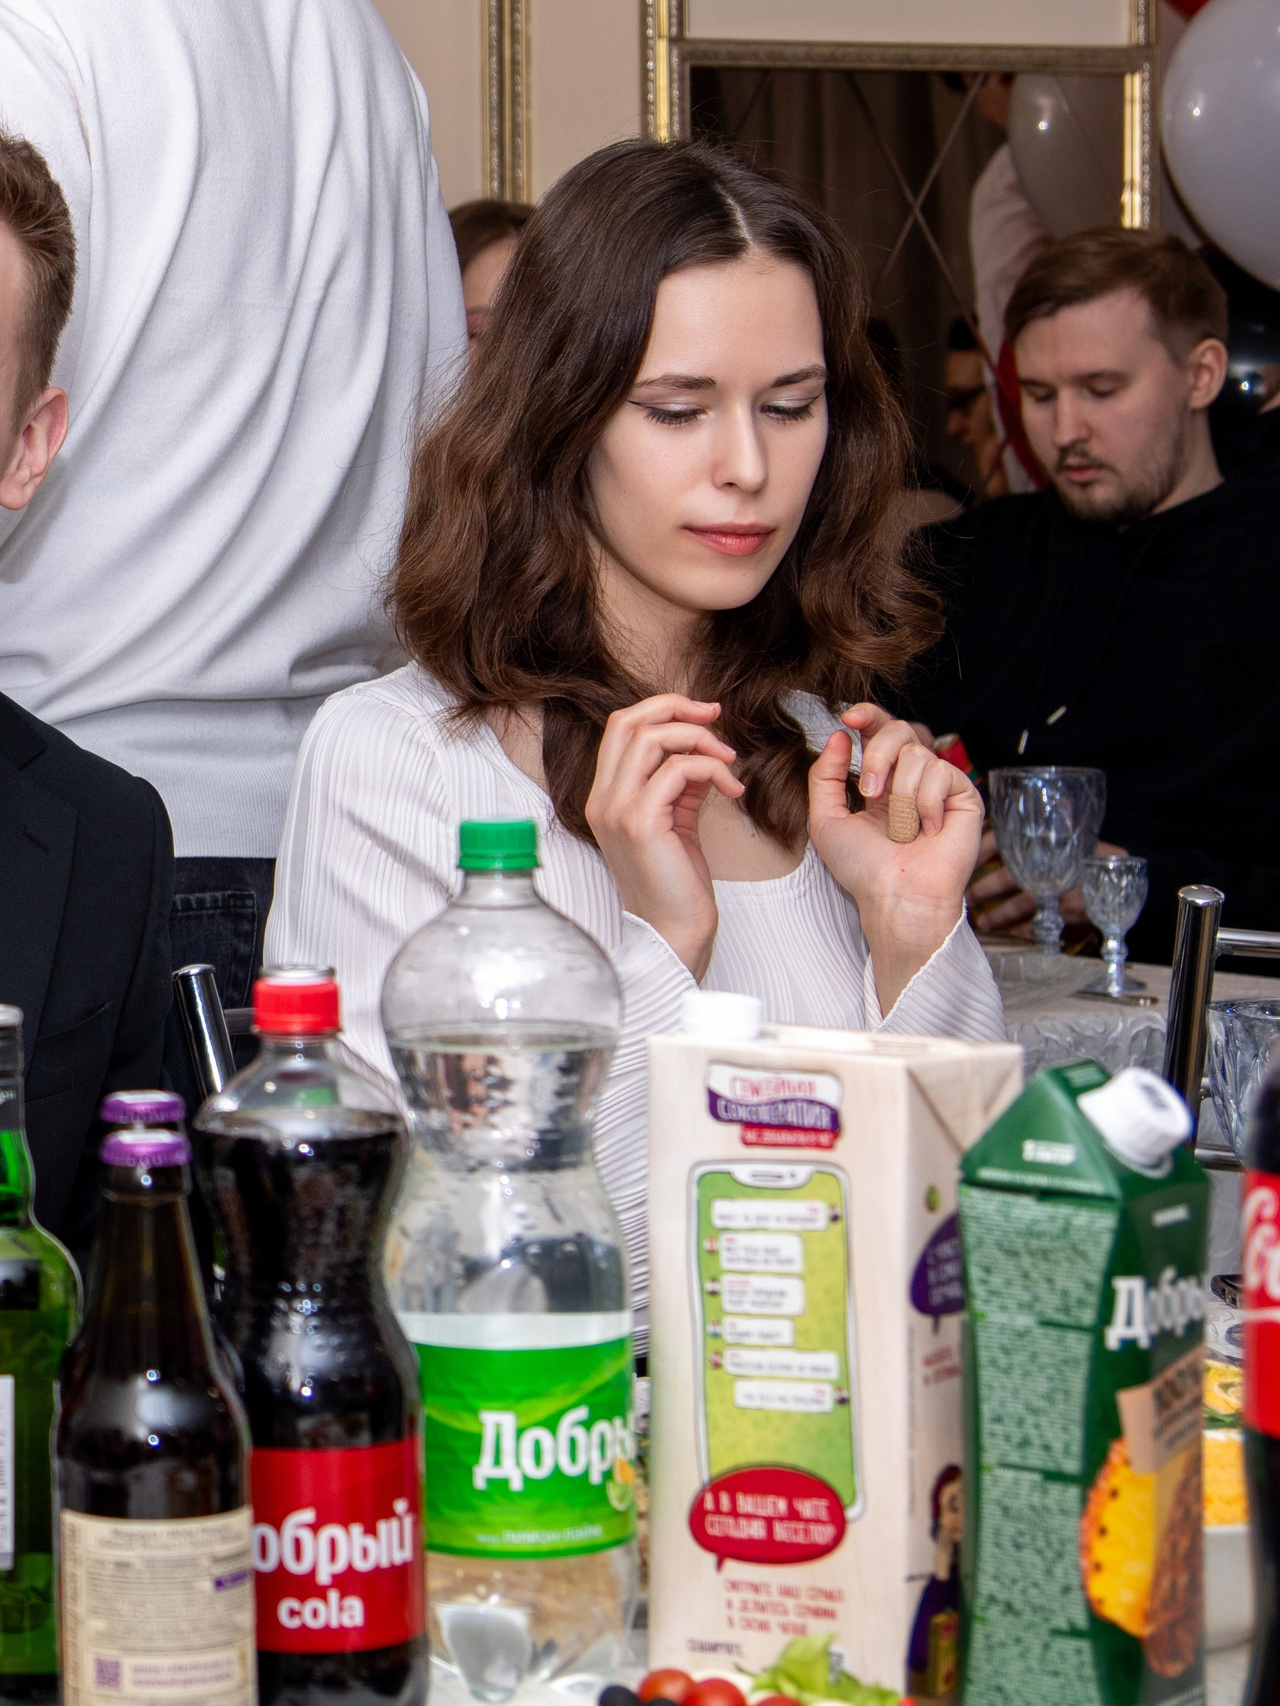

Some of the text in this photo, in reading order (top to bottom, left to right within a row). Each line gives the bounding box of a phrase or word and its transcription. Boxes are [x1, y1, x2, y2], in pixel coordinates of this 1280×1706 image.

[472, 1405, 637, 1492] Добры
[252, 1497, 414, 1586] обрый
[277, 1588, 365, 1630] cola
